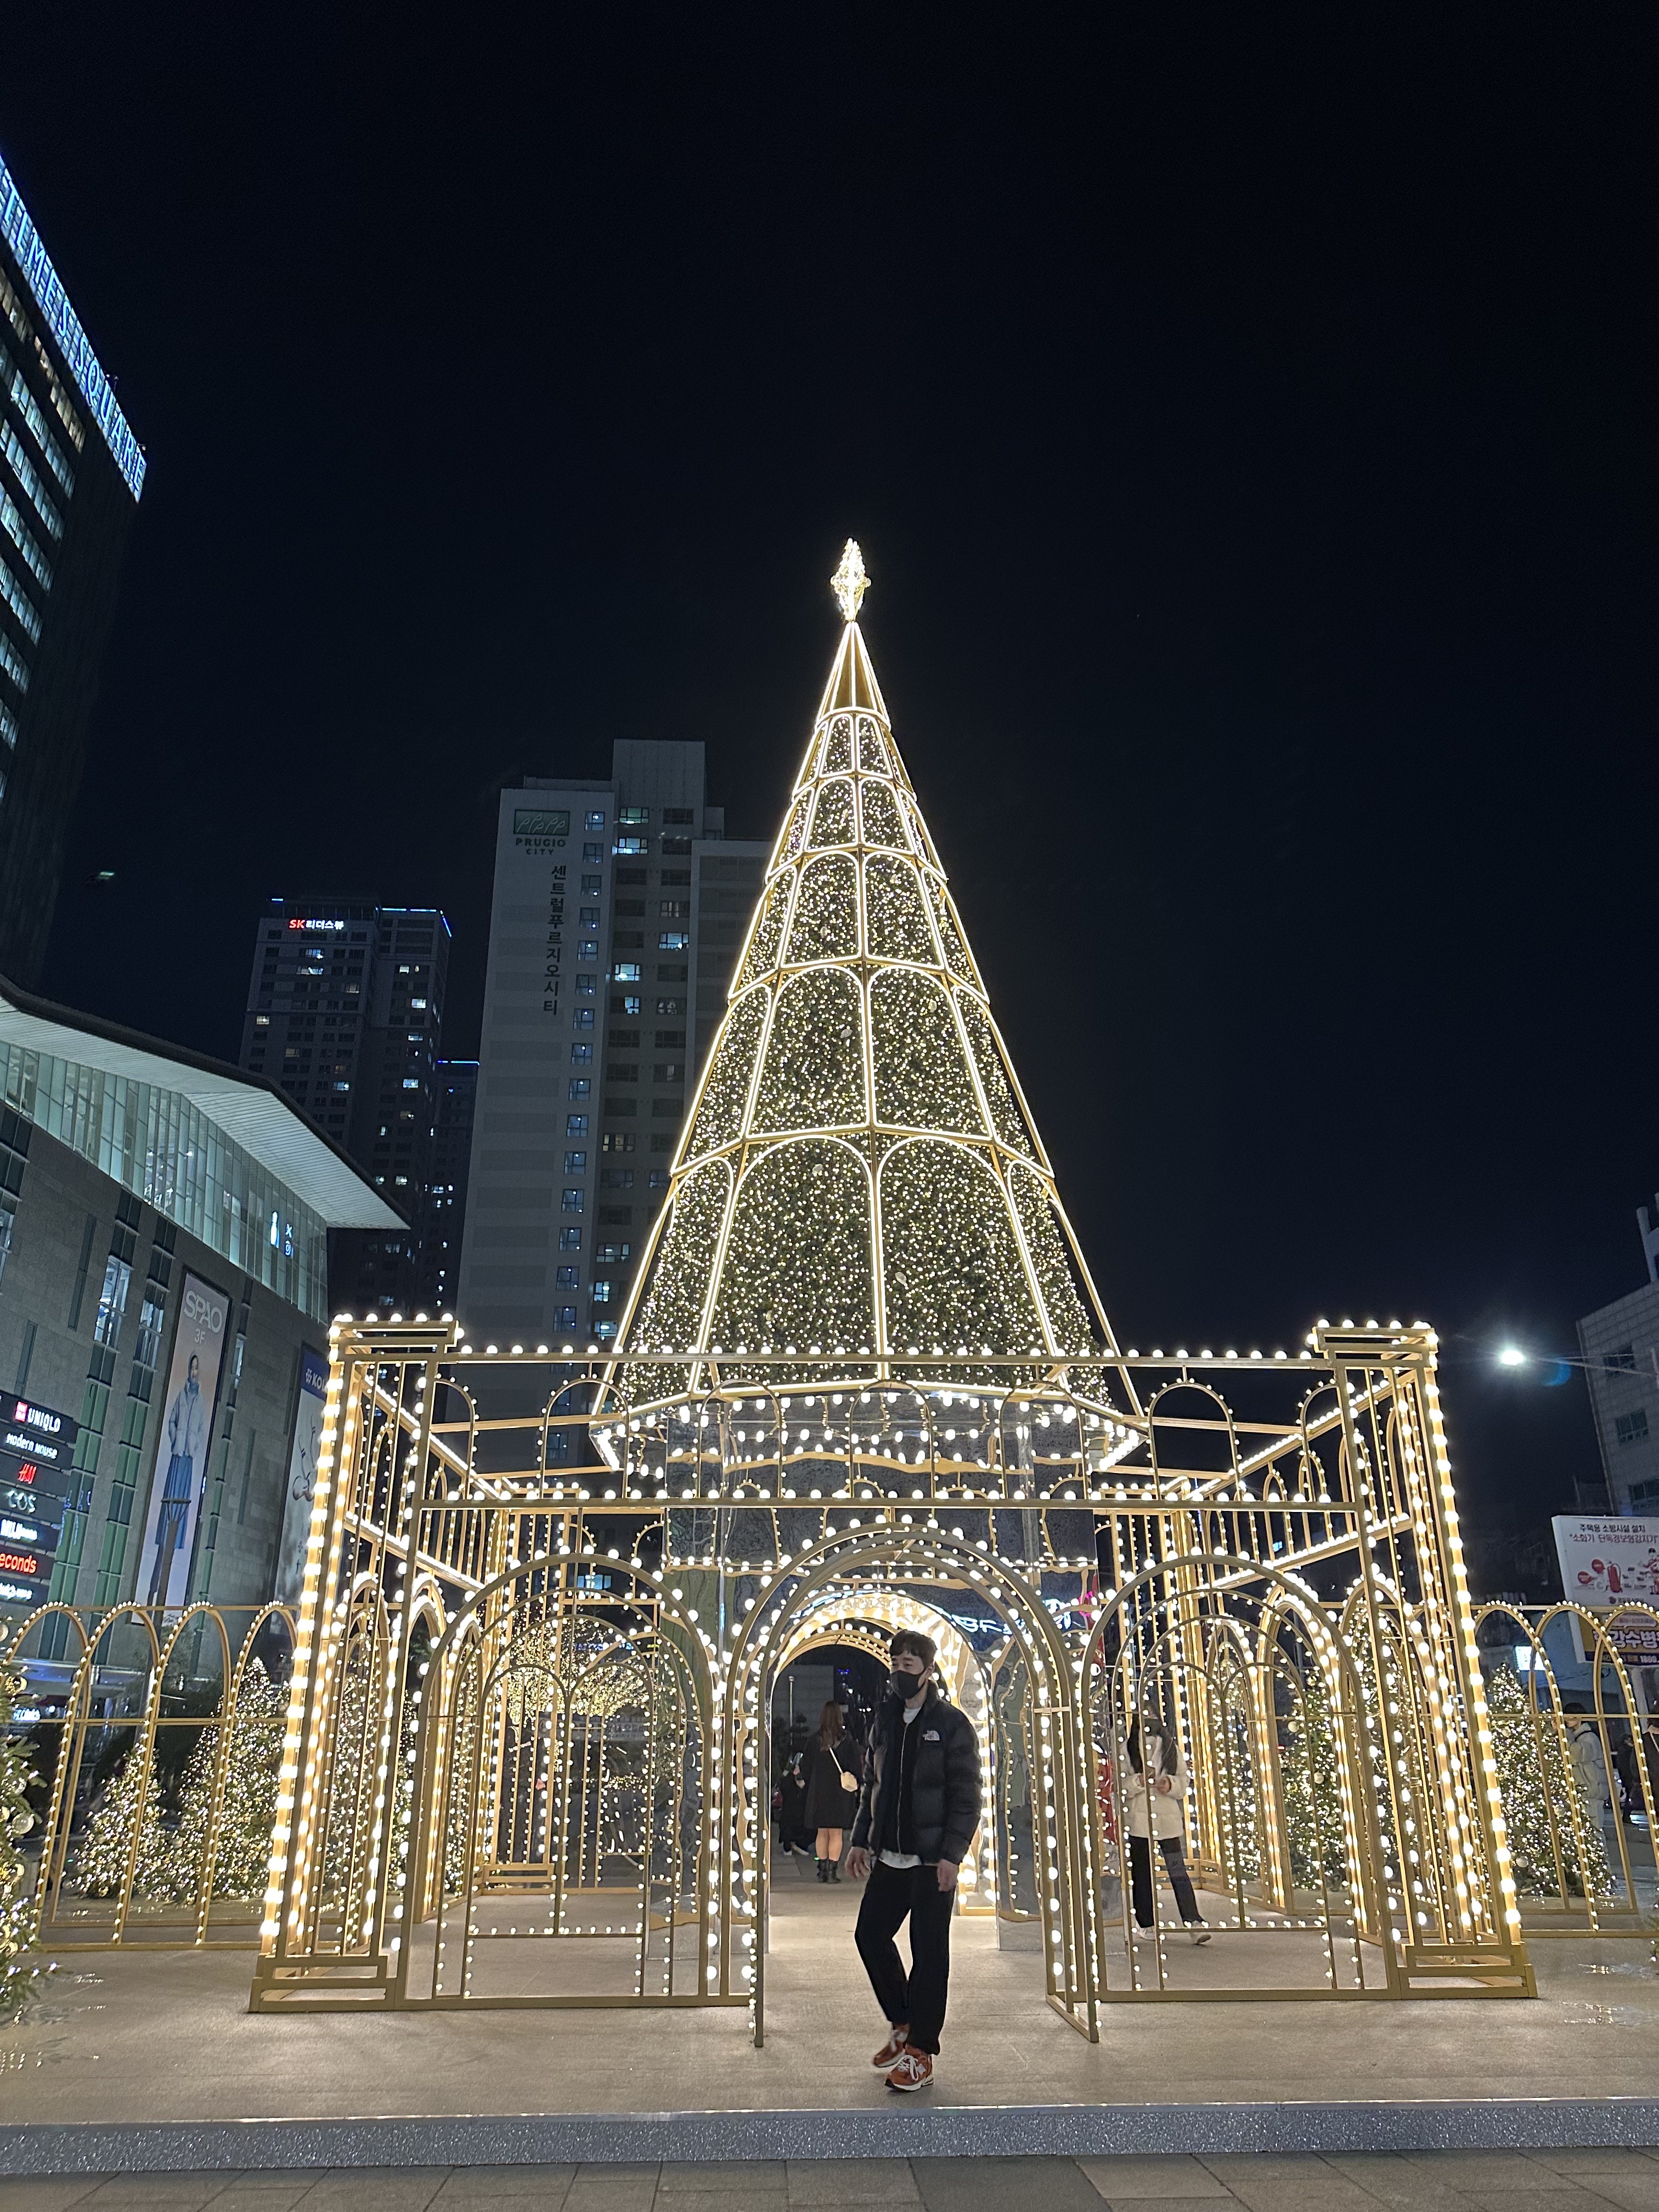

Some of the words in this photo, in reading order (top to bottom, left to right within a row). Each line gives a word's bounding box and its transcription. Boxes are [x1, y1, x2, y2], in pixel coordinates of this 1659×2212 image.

[4, 179, 71, 337] TIMES
[75, 336, 146, 492] SQUARE
[516, 837, 566, 848] PRUGIO
[544, 865, 566, 1015] 센트럴푸르지오시티
[184, 1290, 223, 1334] SPAO
[194, 1328, 206, 1345] 3F
[27, 1407, 61, 1433] UNIQLO
[7, 1490, 37, 1514] COS
